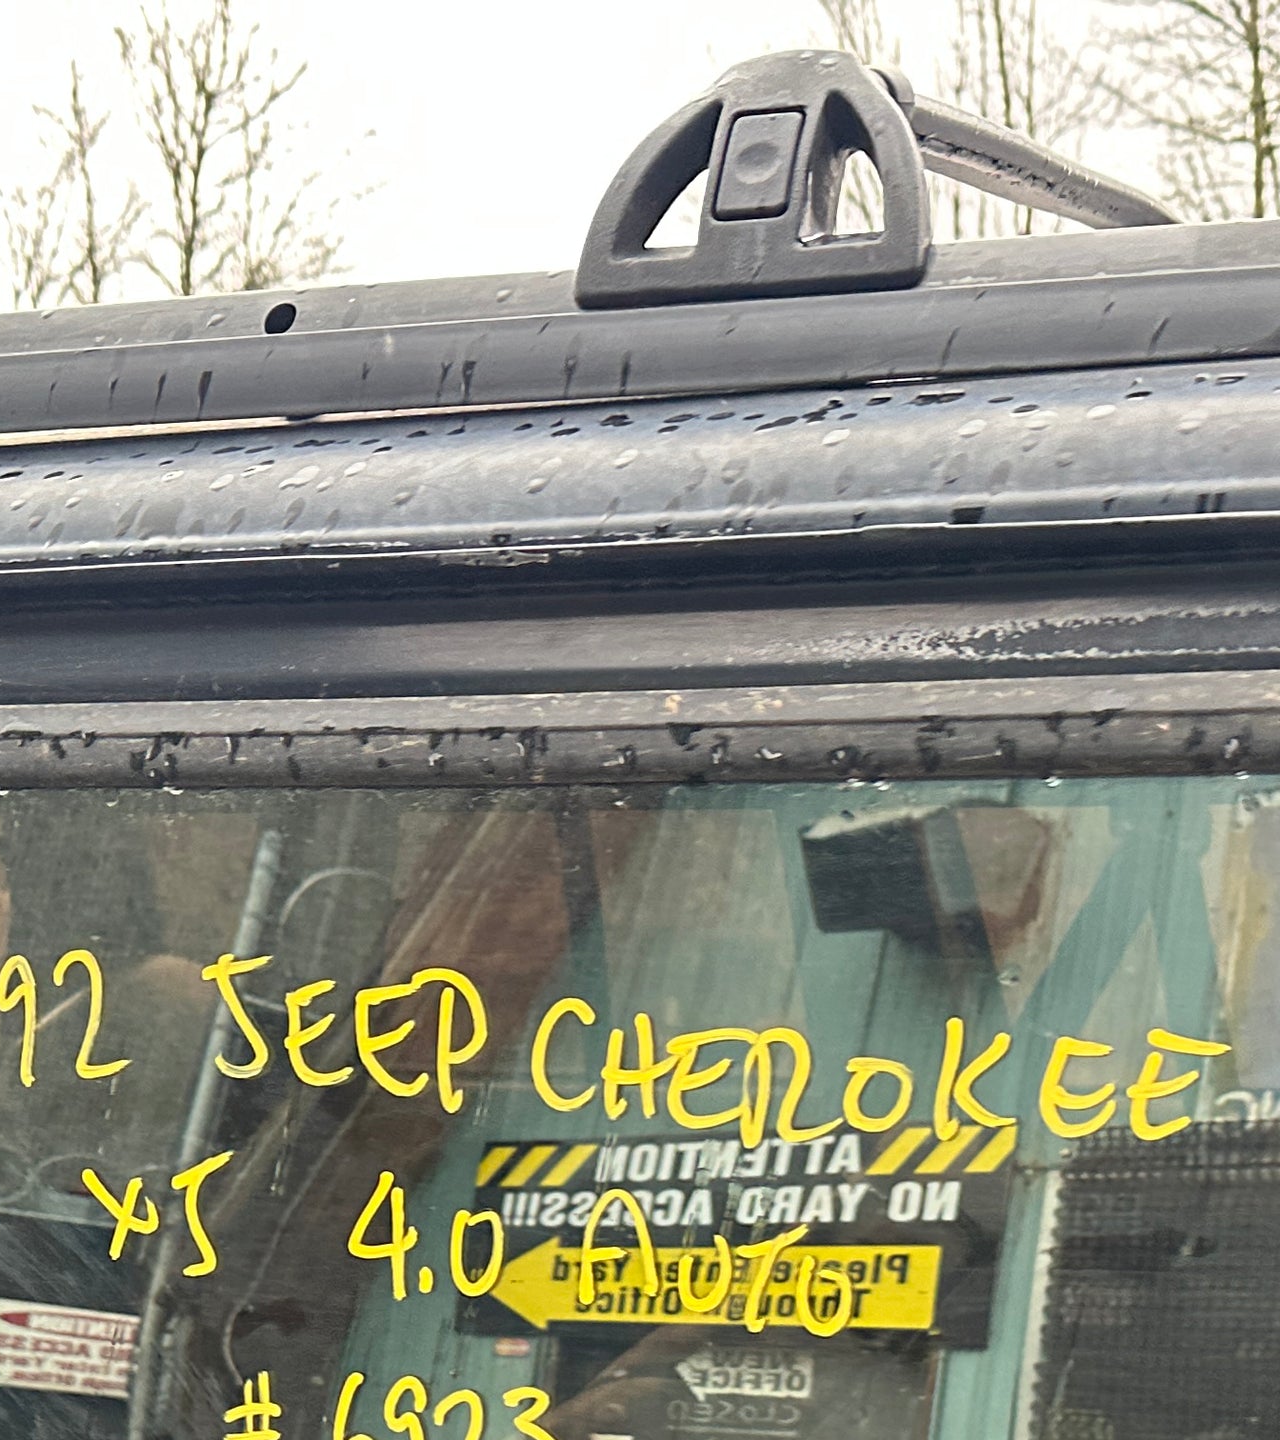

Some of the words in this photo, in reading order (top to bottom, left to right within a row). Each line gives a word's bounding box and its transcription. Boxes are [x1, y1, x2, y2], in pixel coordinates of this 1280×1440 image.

[202, 954, 488, 1113] JEEP
[531, 997, 1231, 1147] CHEROKEE
[81, 1151, 233, 1277] XJ
[347, 1171, 504, 1301] 4.0
[579, 1188, 851, 1337] AUTO
